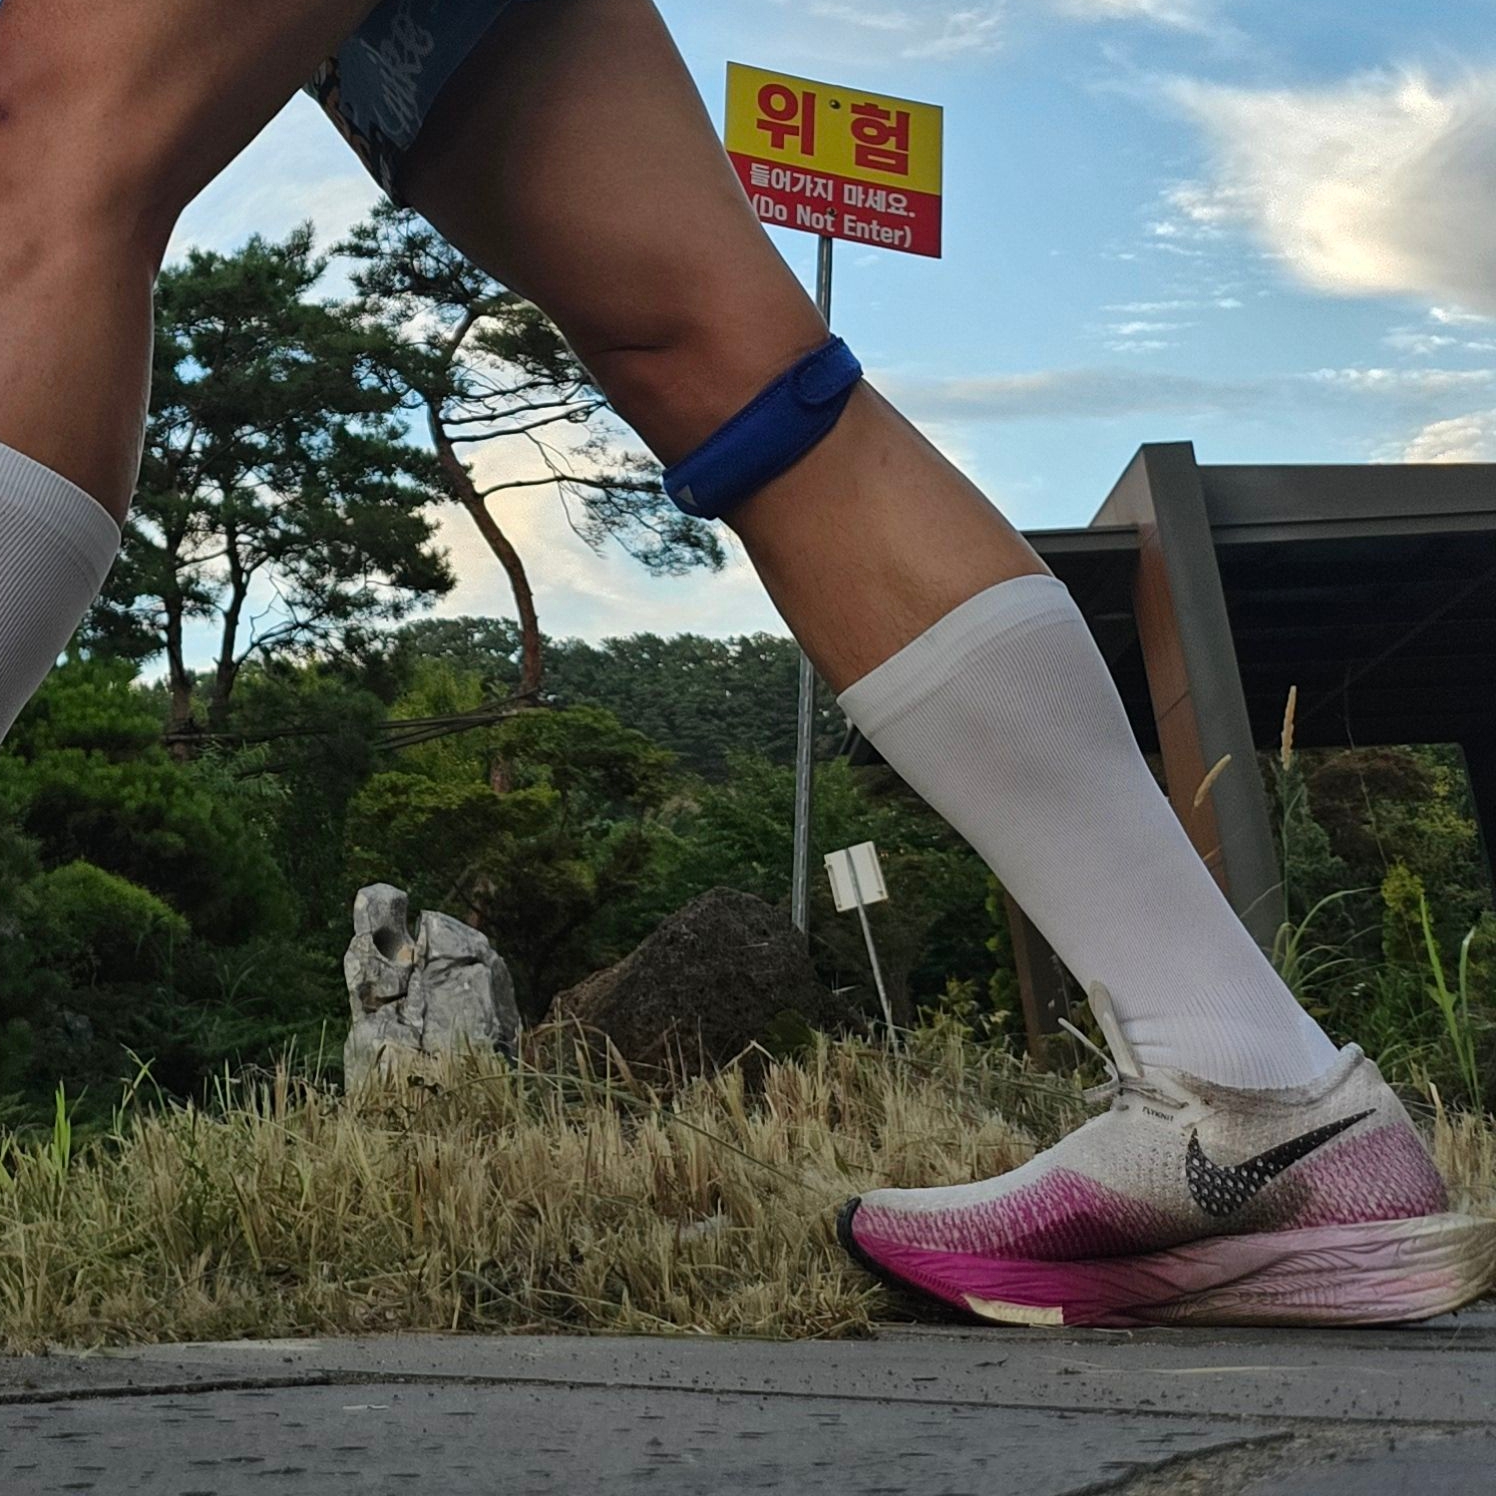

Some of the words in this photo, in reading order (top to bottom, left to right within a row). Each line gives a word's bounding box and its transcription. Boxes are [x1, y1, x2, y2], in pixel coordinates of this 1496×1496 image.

[750, 163, 833, 202] 들어가지
[843, 183, 916, 219] 마세요.
[752, 194, 788, 222] (Do
[796, 204, 836, 232] Not
[843, 214, 912, 248] Enter)
